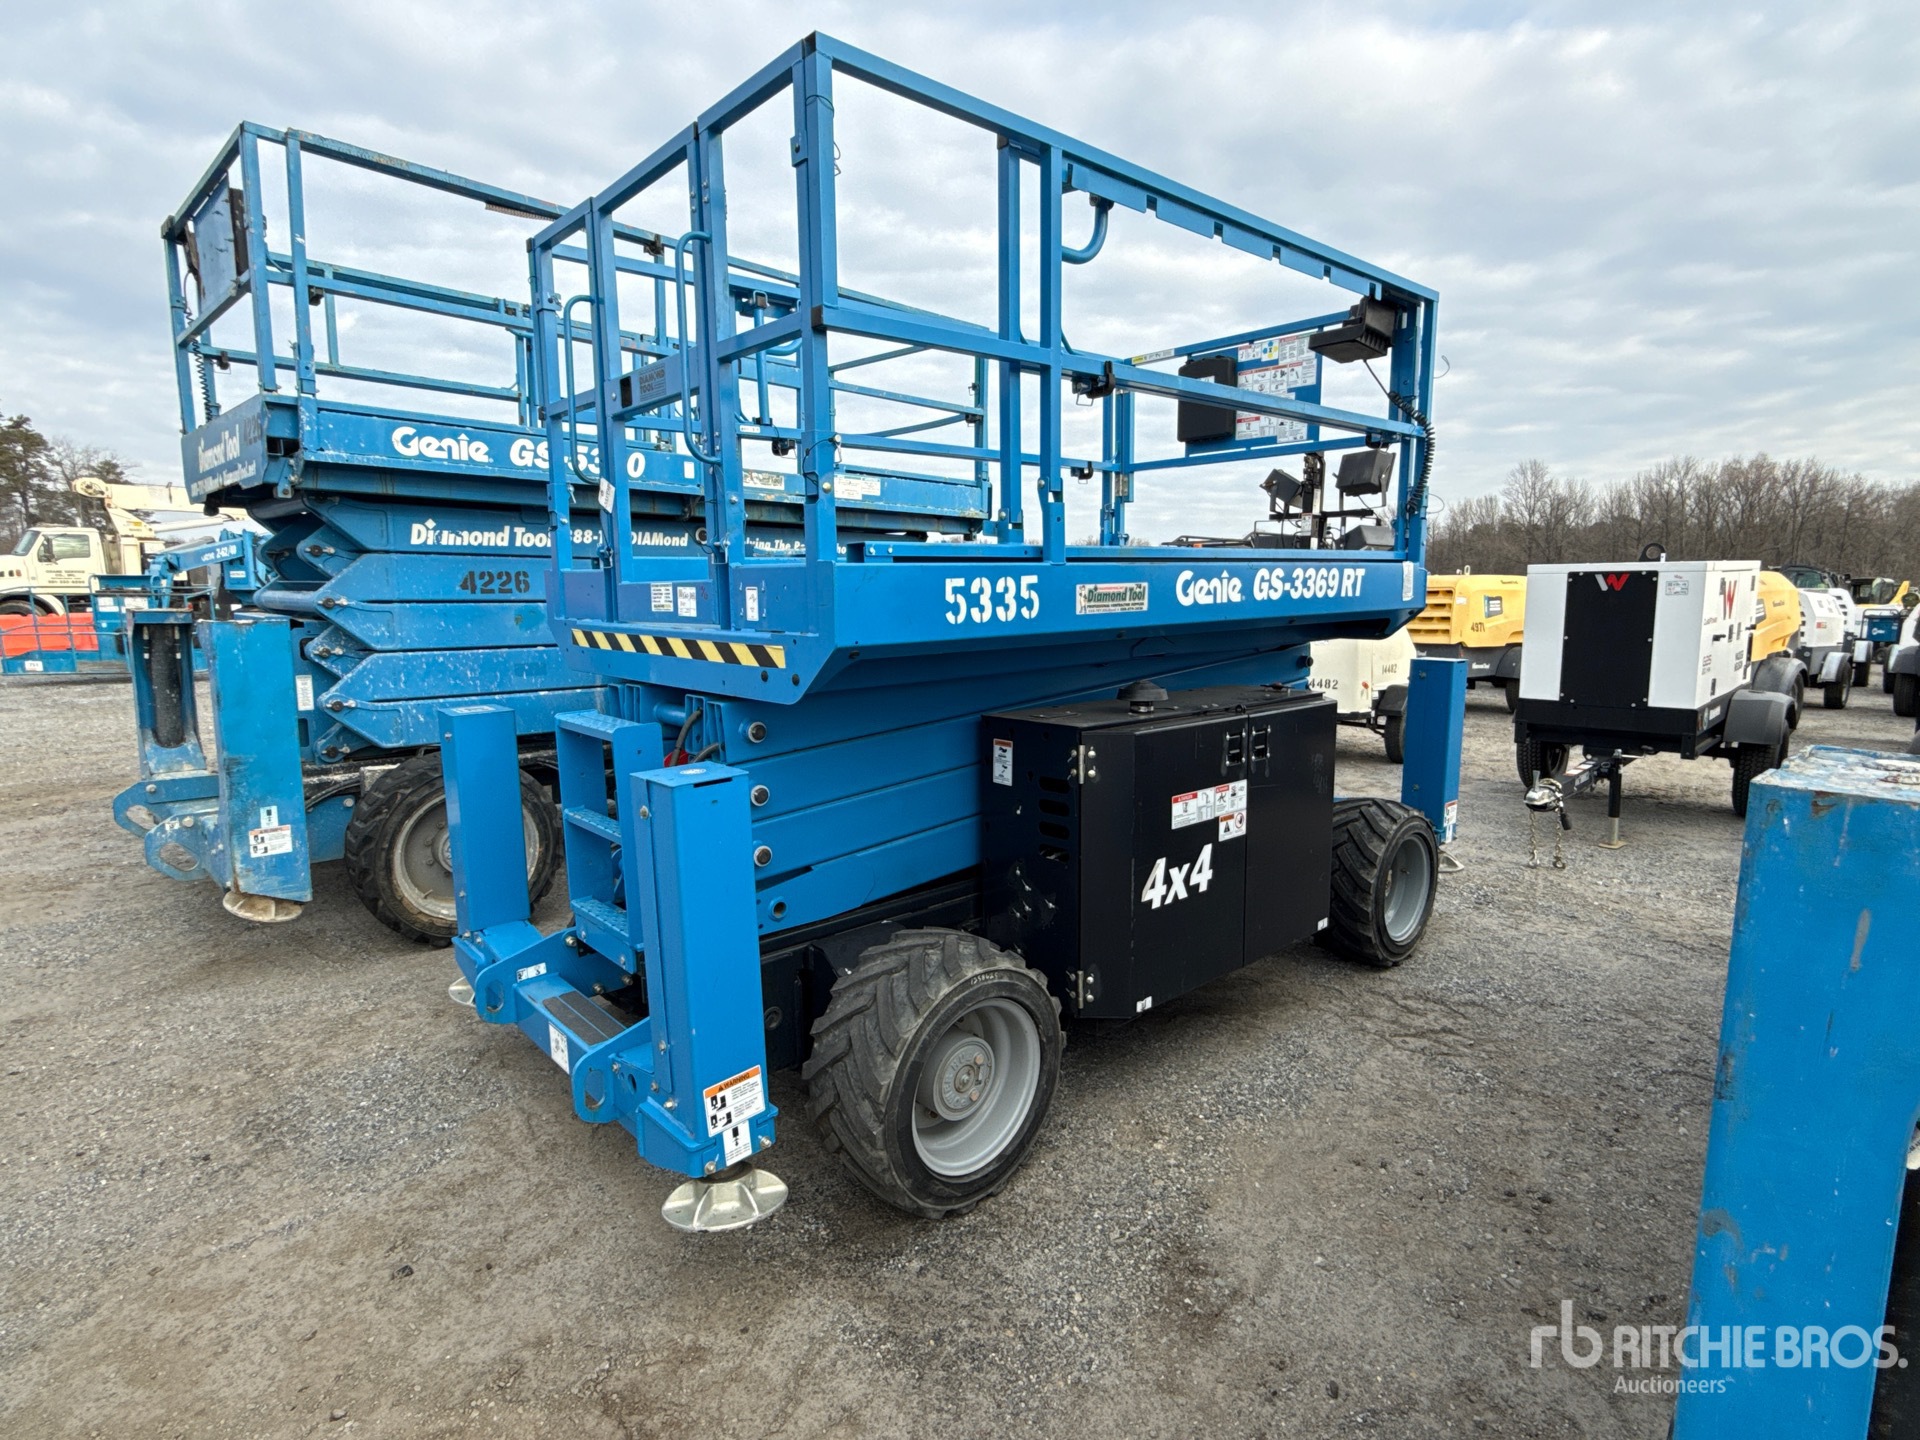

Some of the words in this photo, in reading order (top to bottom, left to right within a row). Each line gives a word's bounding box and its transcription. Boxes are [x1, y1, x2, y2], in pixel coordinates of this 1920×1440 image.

[225, 423, 240, 462] Tool
[392, 426, 491, 463] Genie
[411, 518, 510, 547] Diamond
[459, 569, 530, 595] 4226
[945, 574, 1040, 625] 5335
[1087, 584, 1128, 603] Diamond
[1128, 585, 1146, 602] Tool
[1175, 569, 1243, 607] Genie
[1253, 567, 1340, 601] GS-3369
[1340, 568, 1366, 597] RT
[1141, 842, 1213, 910] 4x4
[724, 1072, 750, 1089] WARNING
